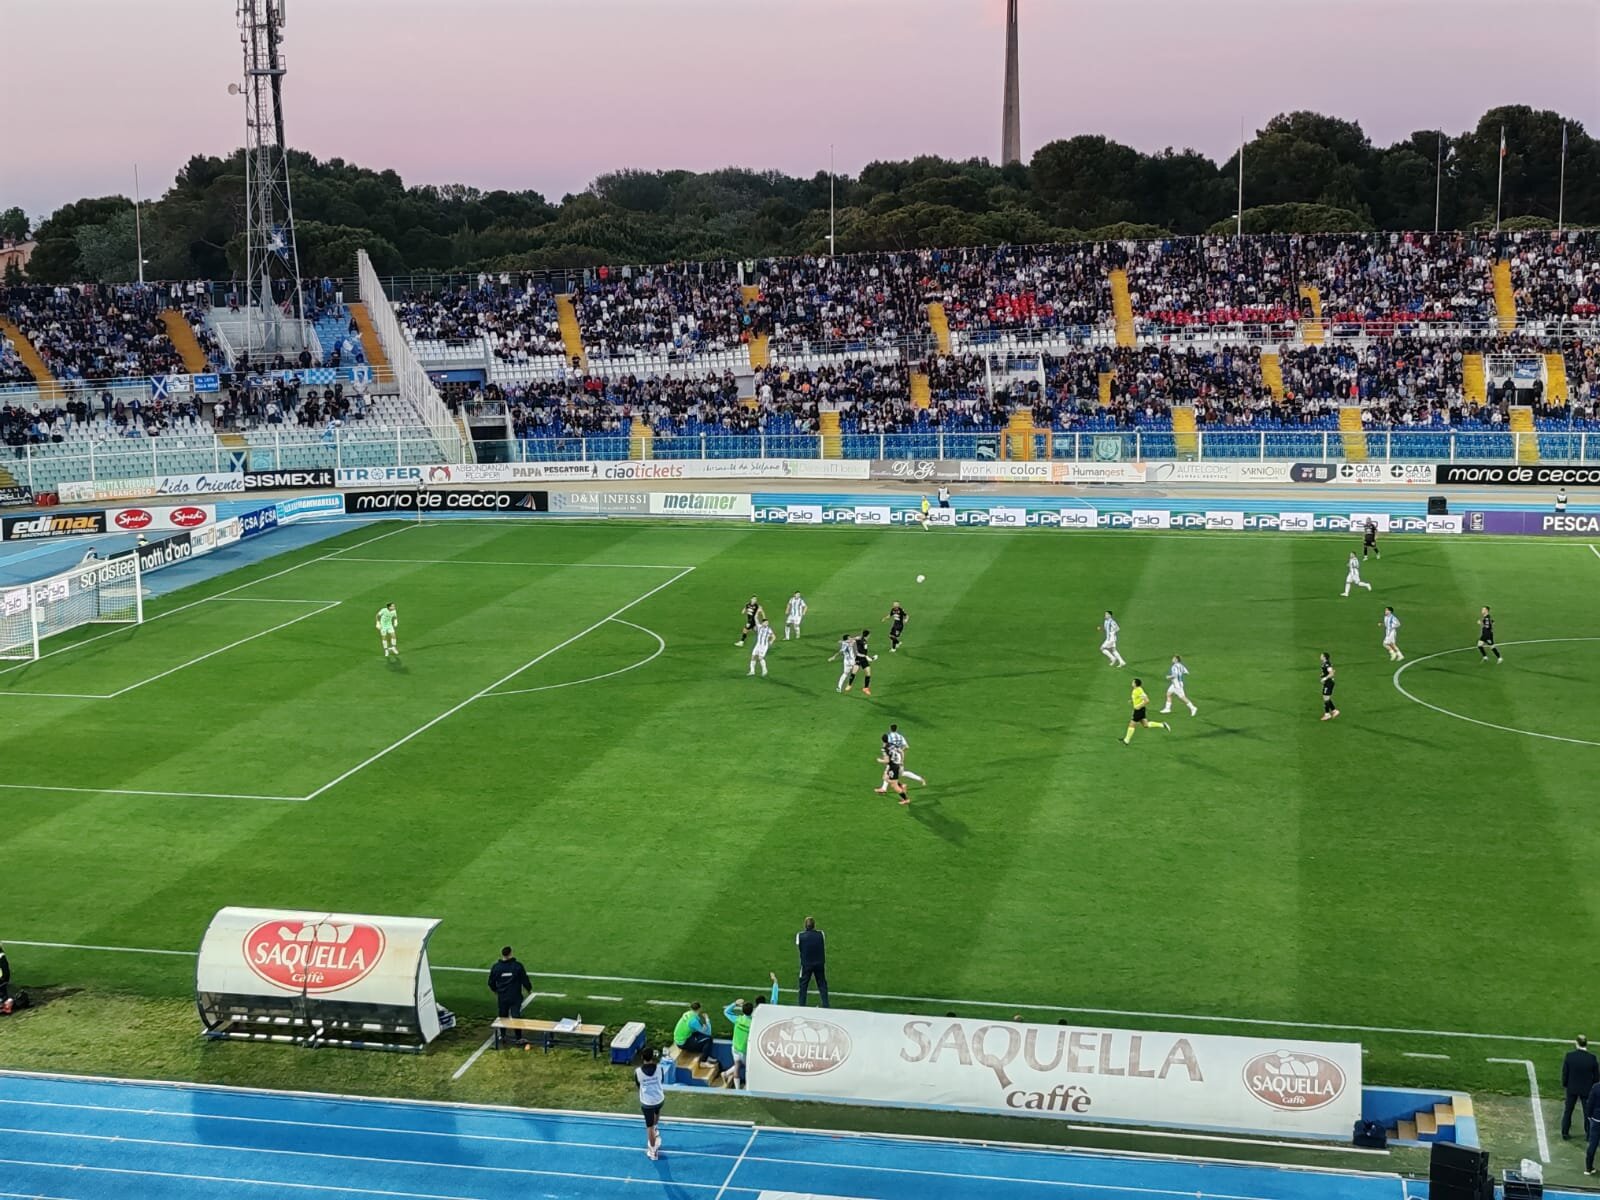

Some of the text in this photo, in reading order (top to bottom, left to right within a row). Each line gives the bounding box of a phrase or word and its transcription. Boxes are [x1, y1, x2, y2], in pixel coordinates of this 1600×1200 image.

[543, 465, 590, 473] PESCATORE
[605, 463, 683, 478] ciaotickets
[962, 464, 991, 474] work
[996, 464, 1006, 474] in
[1010, 464, 1048, 475] colors
[1072, 467, 1125, 477] Humangest
[1356, 465, 1380, 473] CATA
[1406, 465, 1431, 473] CATA
[1448, 466, 1600, 482] mario de cecco
[157, 476, 243, 494] Lido Oriente
[245, 473, 332, 487] SISMEX.it
[357, 494, 412, 509] mario
[417, 492, 442, 507] de
[446, 494, 510, 508] cecco
[571, 494, 647, 504] D&M INFISSI
[663, 494, 737, 510] metamer
[244, 516, 259, 530] CSA
[264, 510, 277, 523] CSA
[12, 516, 102, 534] edimac
[141, 547, 165, 571] notti
[254, 942, 366, 973] SAQUELLA
[292, 971, 325, 984] caffè
[766, 1041, 842, 1065] SAQUELLA
[900, 1020, 1204, 1089] SAQUELLA
[791, 1060, 814, 1070] caffè
[1252, 1074, 1336, 1099] SAQUELLA
[1006, 1084, 1092, 1113] caffè
[1281, 1095, 1307, 1105] caffè
